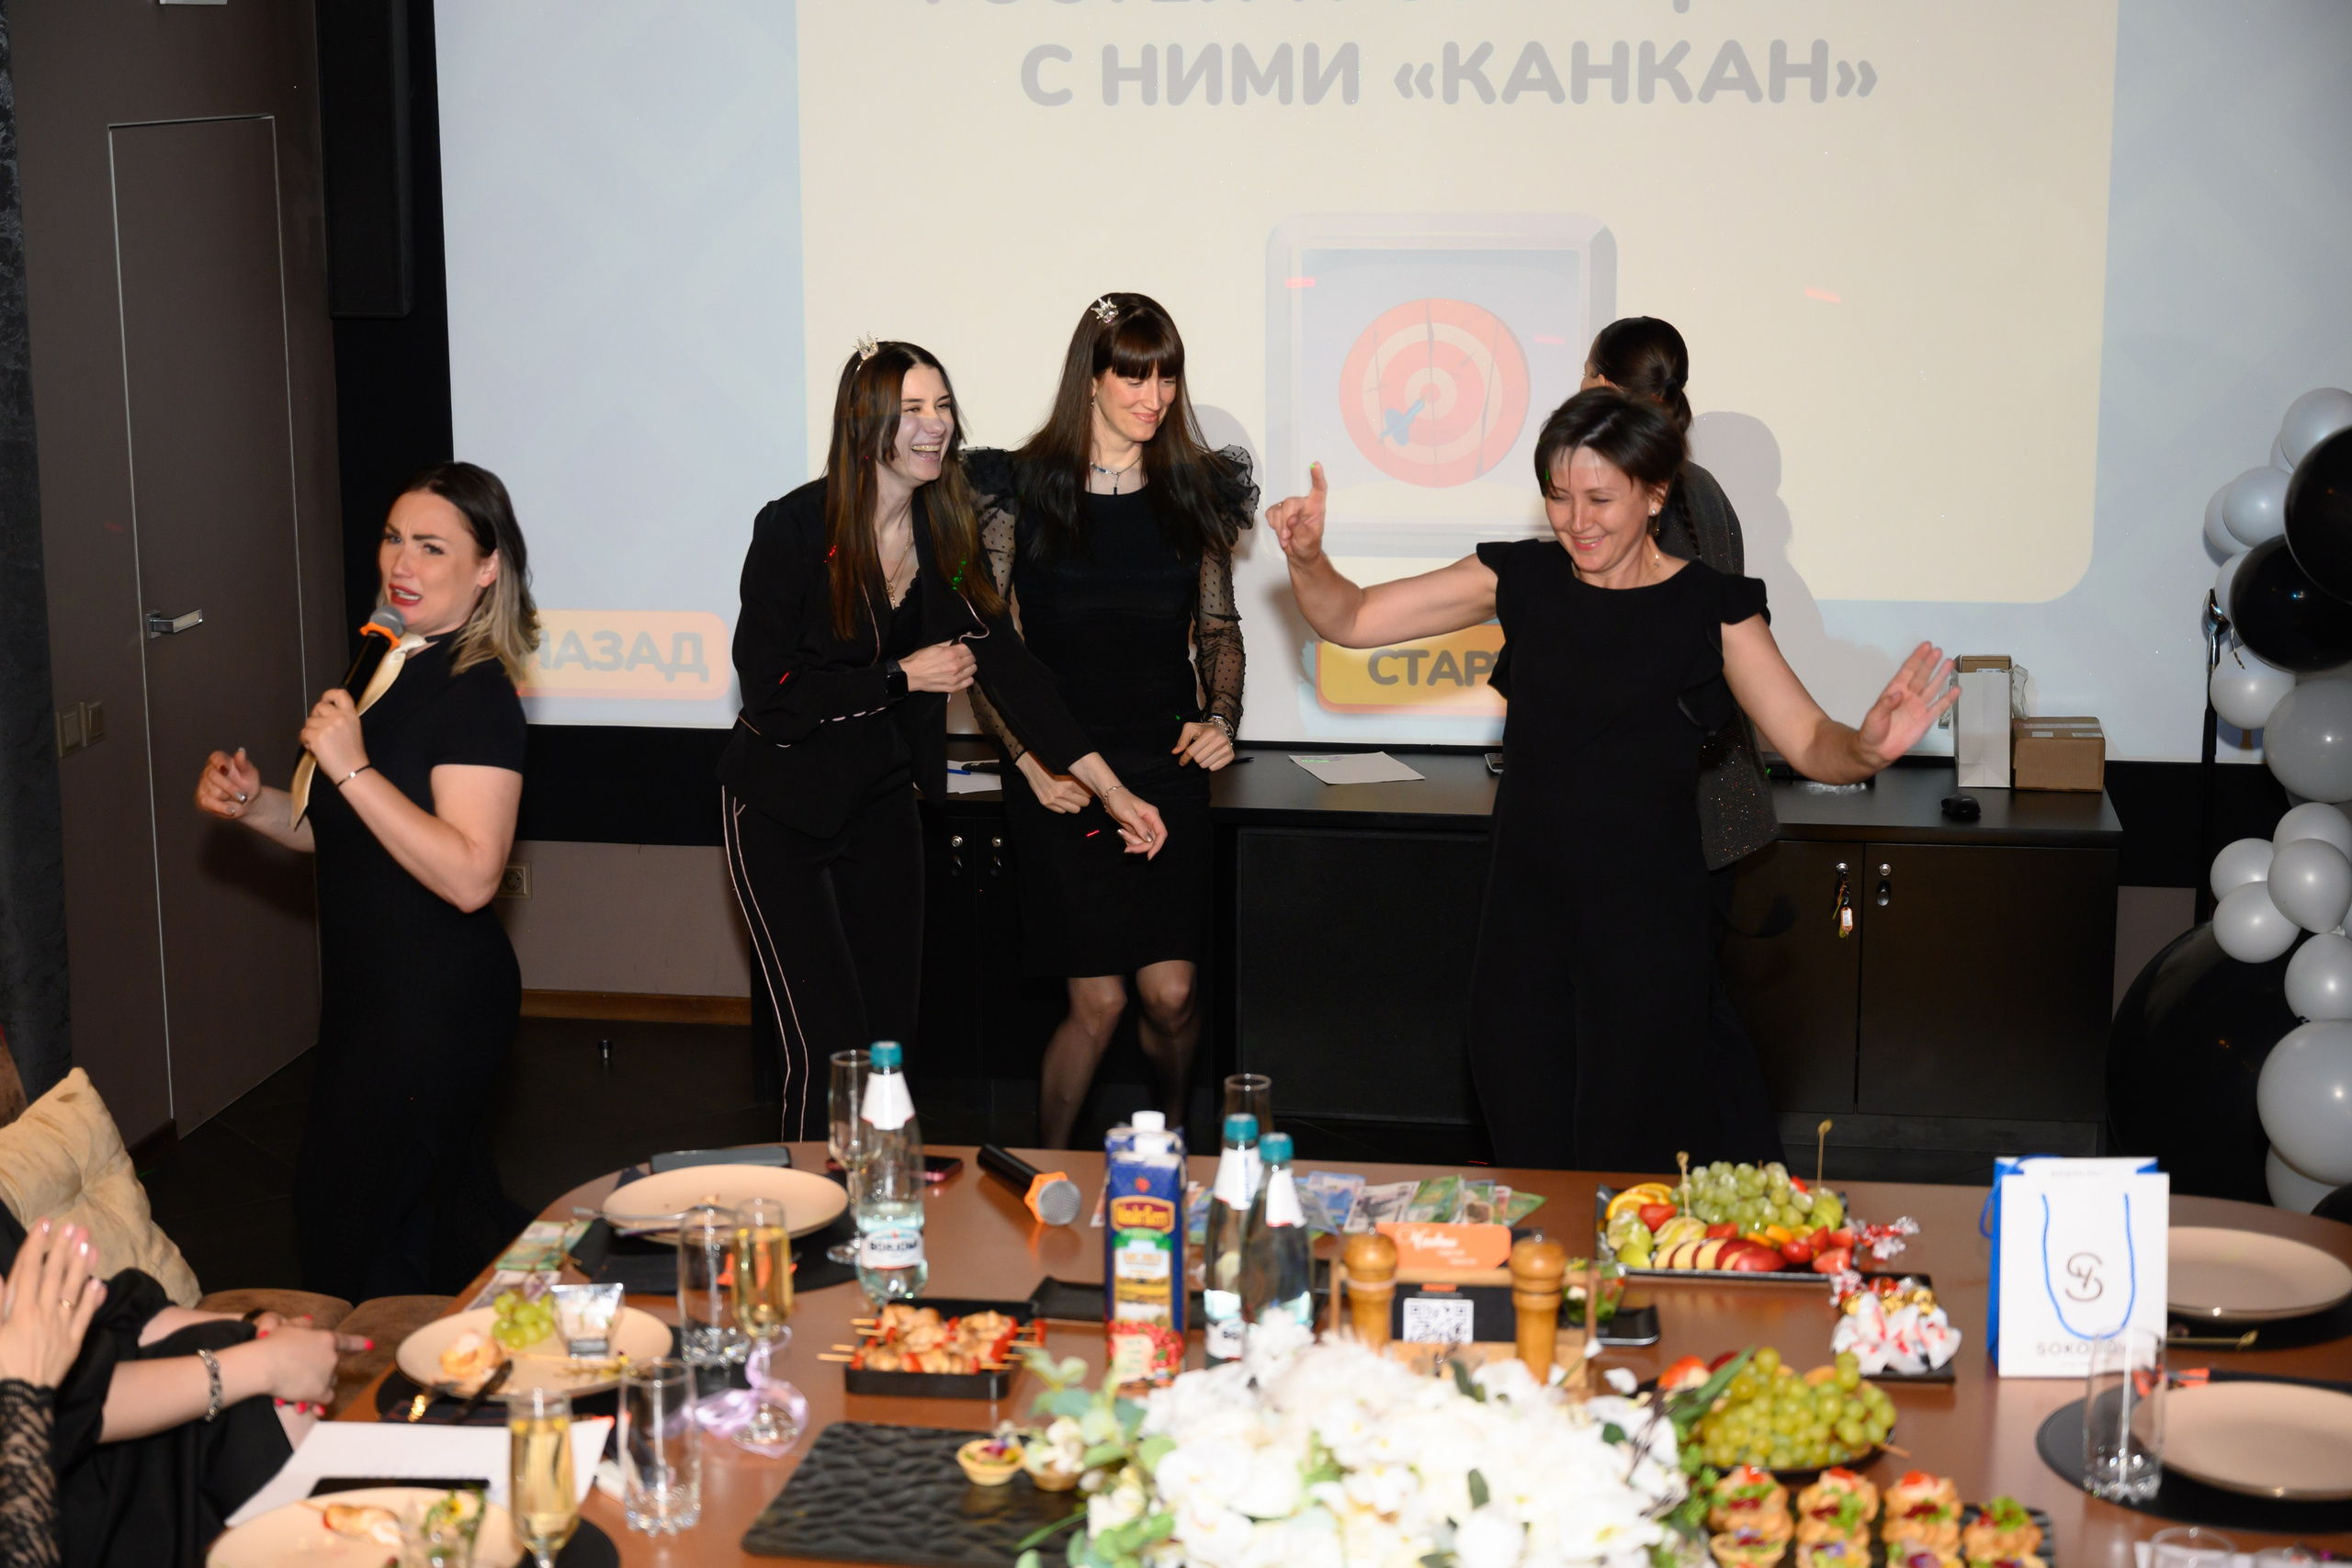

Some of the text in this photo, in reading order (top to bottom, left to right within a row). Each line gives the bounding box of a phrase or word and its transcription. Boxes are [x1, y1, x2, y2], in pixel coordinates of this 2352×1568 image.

[1020, 38, 1879, 107] С НИМИ «КАНКАН»
[1367, 648, 1500, 687] СТАР
